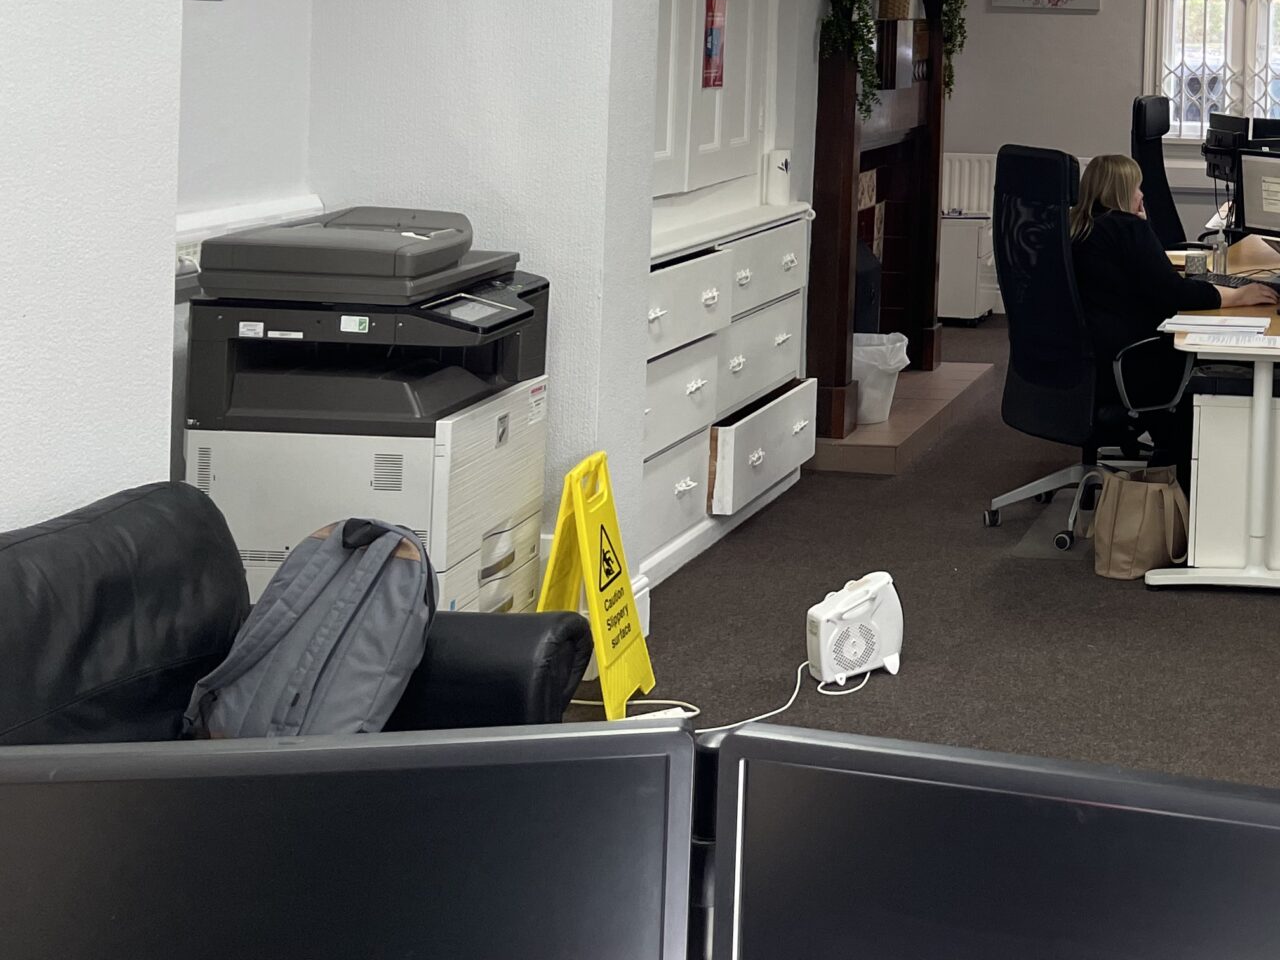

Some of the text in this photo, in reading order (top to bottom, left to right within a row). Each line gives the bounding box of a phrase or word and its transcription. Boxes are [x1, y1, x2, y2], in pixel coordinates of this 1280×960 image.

[604, 586, 625, 612] Caution
[606, 603, 629, 632] Slippery
[611, 621, 632, 649] surface
